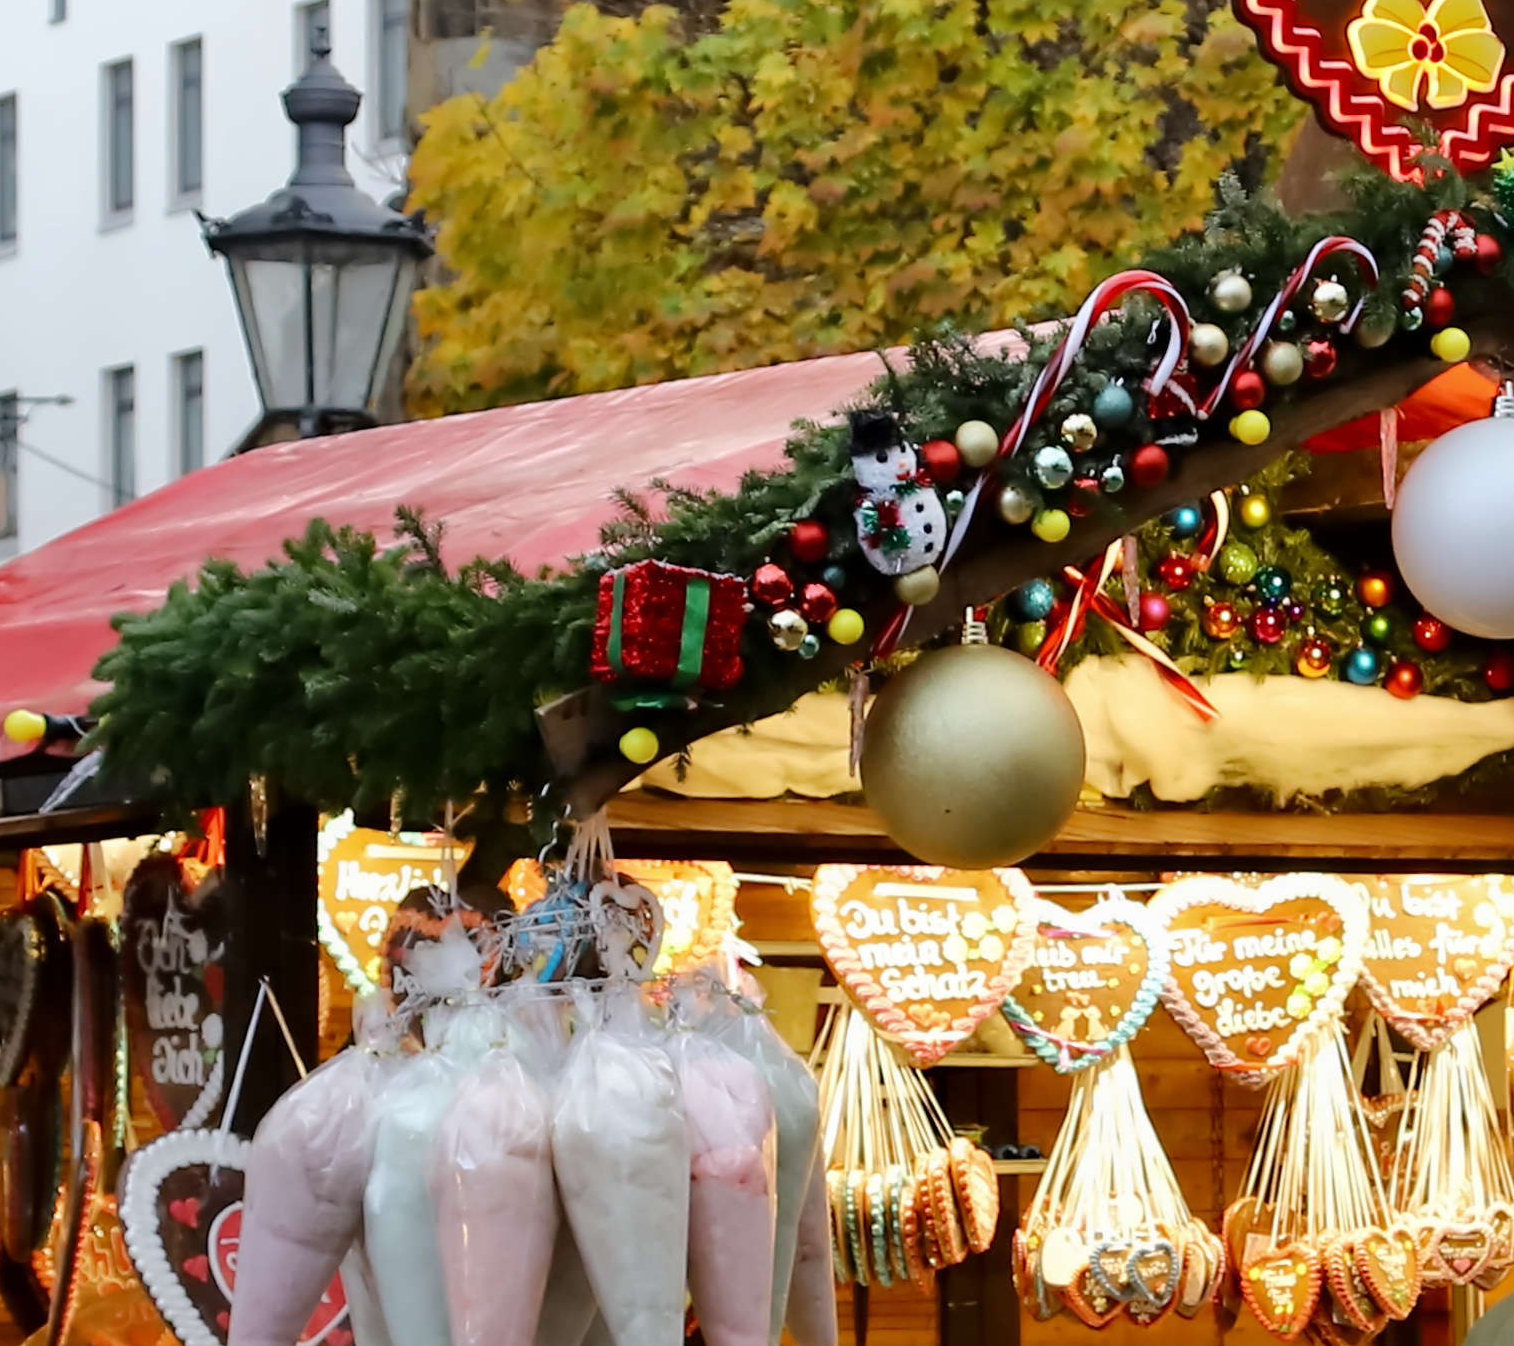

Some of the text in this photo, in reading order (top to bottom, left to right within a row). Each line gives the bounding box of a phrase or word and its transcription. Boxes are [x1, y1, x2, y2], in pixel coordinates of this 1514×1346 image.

[840, 898, 963, 939] Du bist
[1400, 882, 1463, 920] bist
[857, 936, 944, 968] mein
[1169, 927, 1319, 967] Für meine
[880, 963, 987, 1003] Schatz
[1190, 965, 1287, 1009] große
[1389, 968, 1462, 1000] mich
